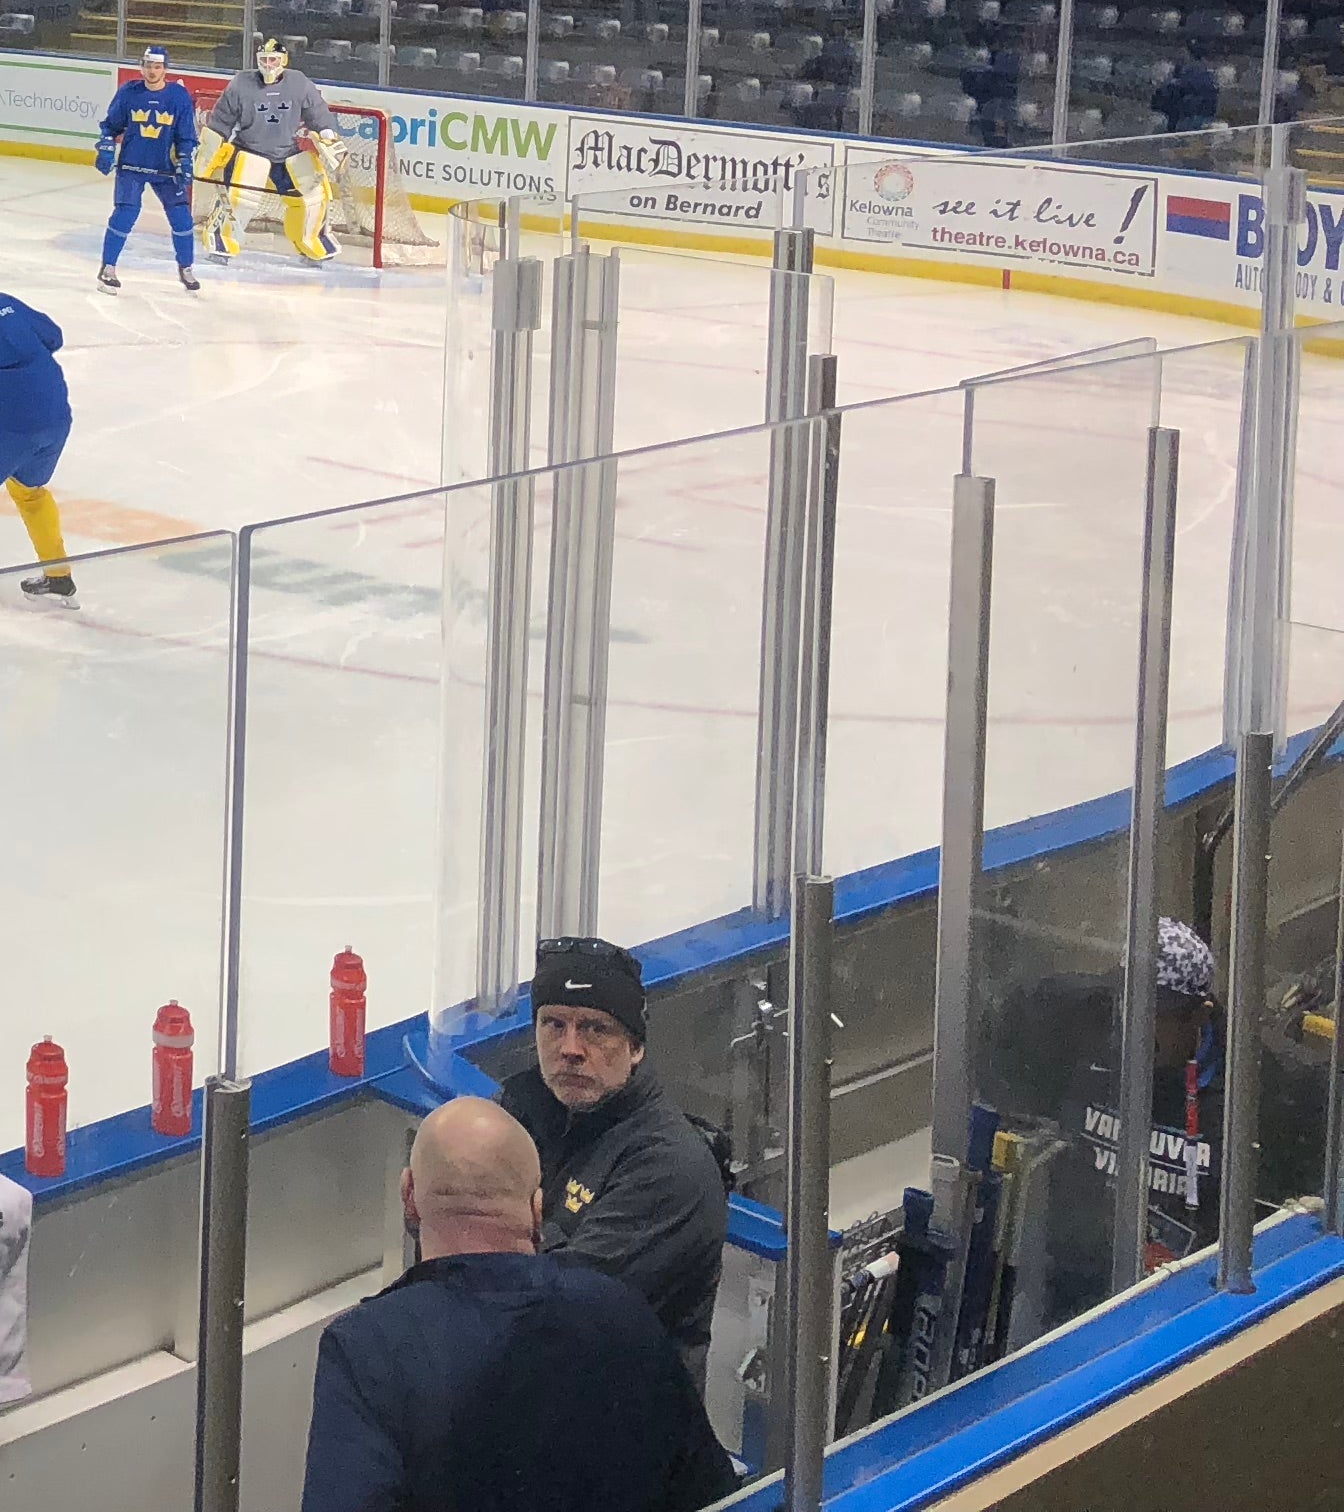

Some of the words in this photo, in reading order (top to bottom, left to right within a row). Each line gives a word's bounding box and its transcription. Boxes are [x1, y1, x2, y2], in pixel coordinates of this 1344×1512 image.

[442, 165, 554, 195] SOLUTIONS
[630, 193, 655, 210] on
[665, 194, 762, 220] Bernard
[849, 200, 913, 217] Kelowna
[932, 200, 976, 217] see
[991, 199, 1020, 222] it
[867, 216, 919, 230] Community
[867, 228, 902, 239] Theatre
[932, 226, 1141, 267] theatre.kelowna.ca
[1324, 277, 1332, 303] &
